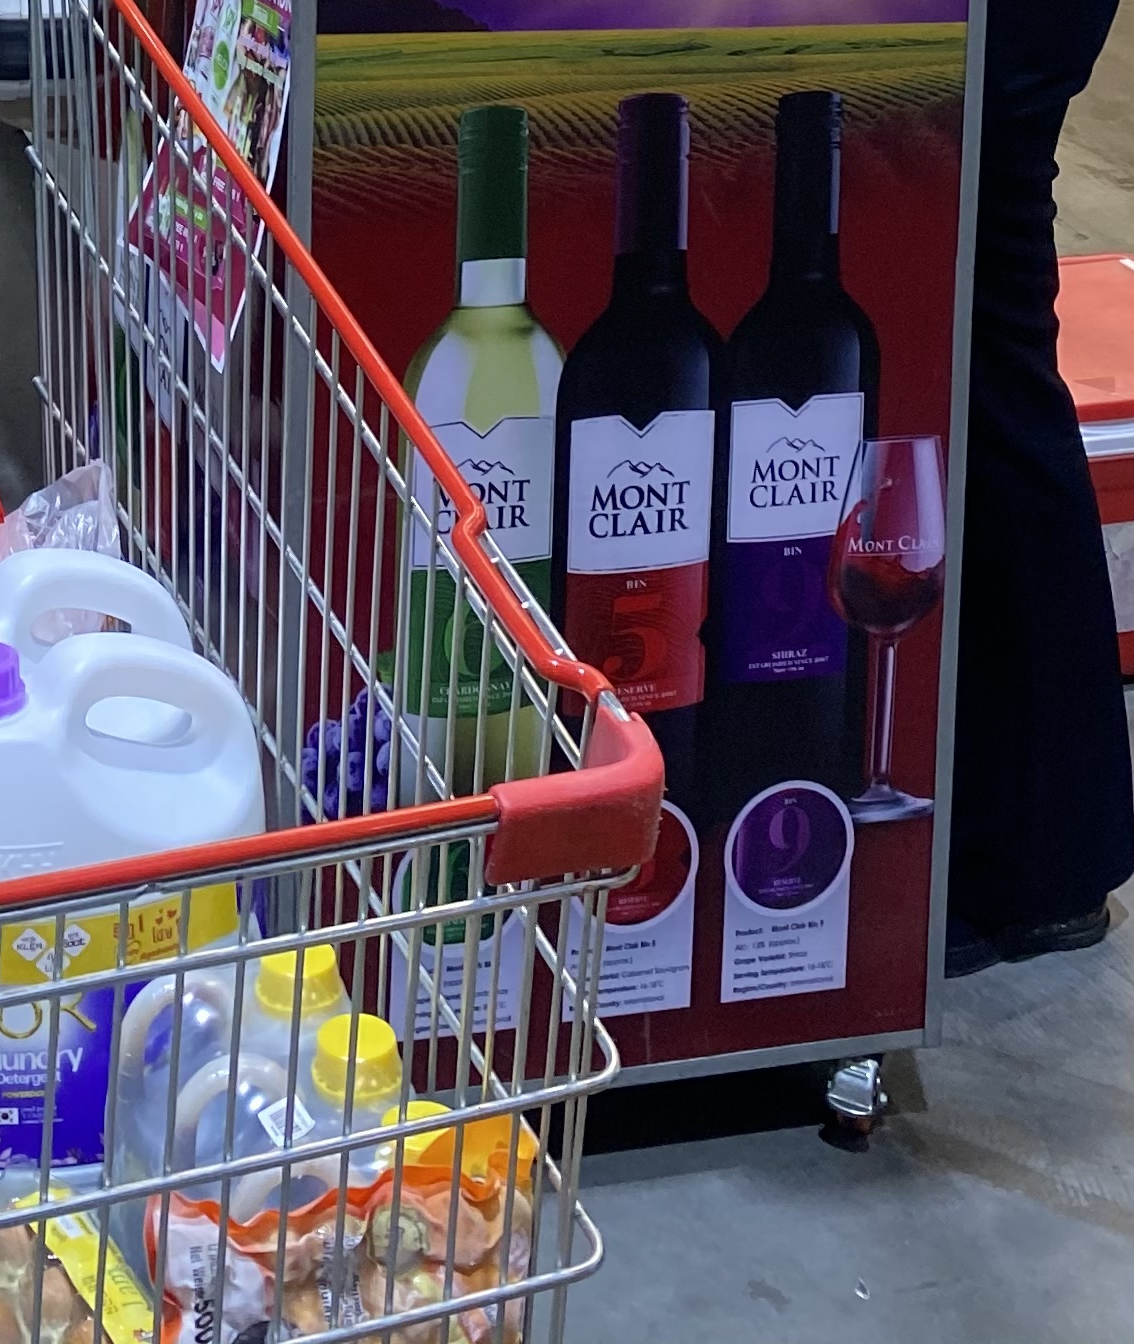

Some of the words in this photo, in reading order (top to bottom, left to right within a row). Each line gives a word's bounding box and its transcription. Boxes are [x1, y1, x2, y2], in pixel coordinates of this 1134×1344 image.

[750, 455, 841, 484] MONT
[590, 480, 691, 512] MONT
[749, 480, 840, 509] CLAIR
[588, 507, 690, 539] CLAIR
[783, 546, 802, 557] BIN
[847, 536, 894, 553] MONT
[626, 579, 648, 590] BIN
[603, 593, 669, 681] 5
[771, 648, 808, 660] SHIRAZ
